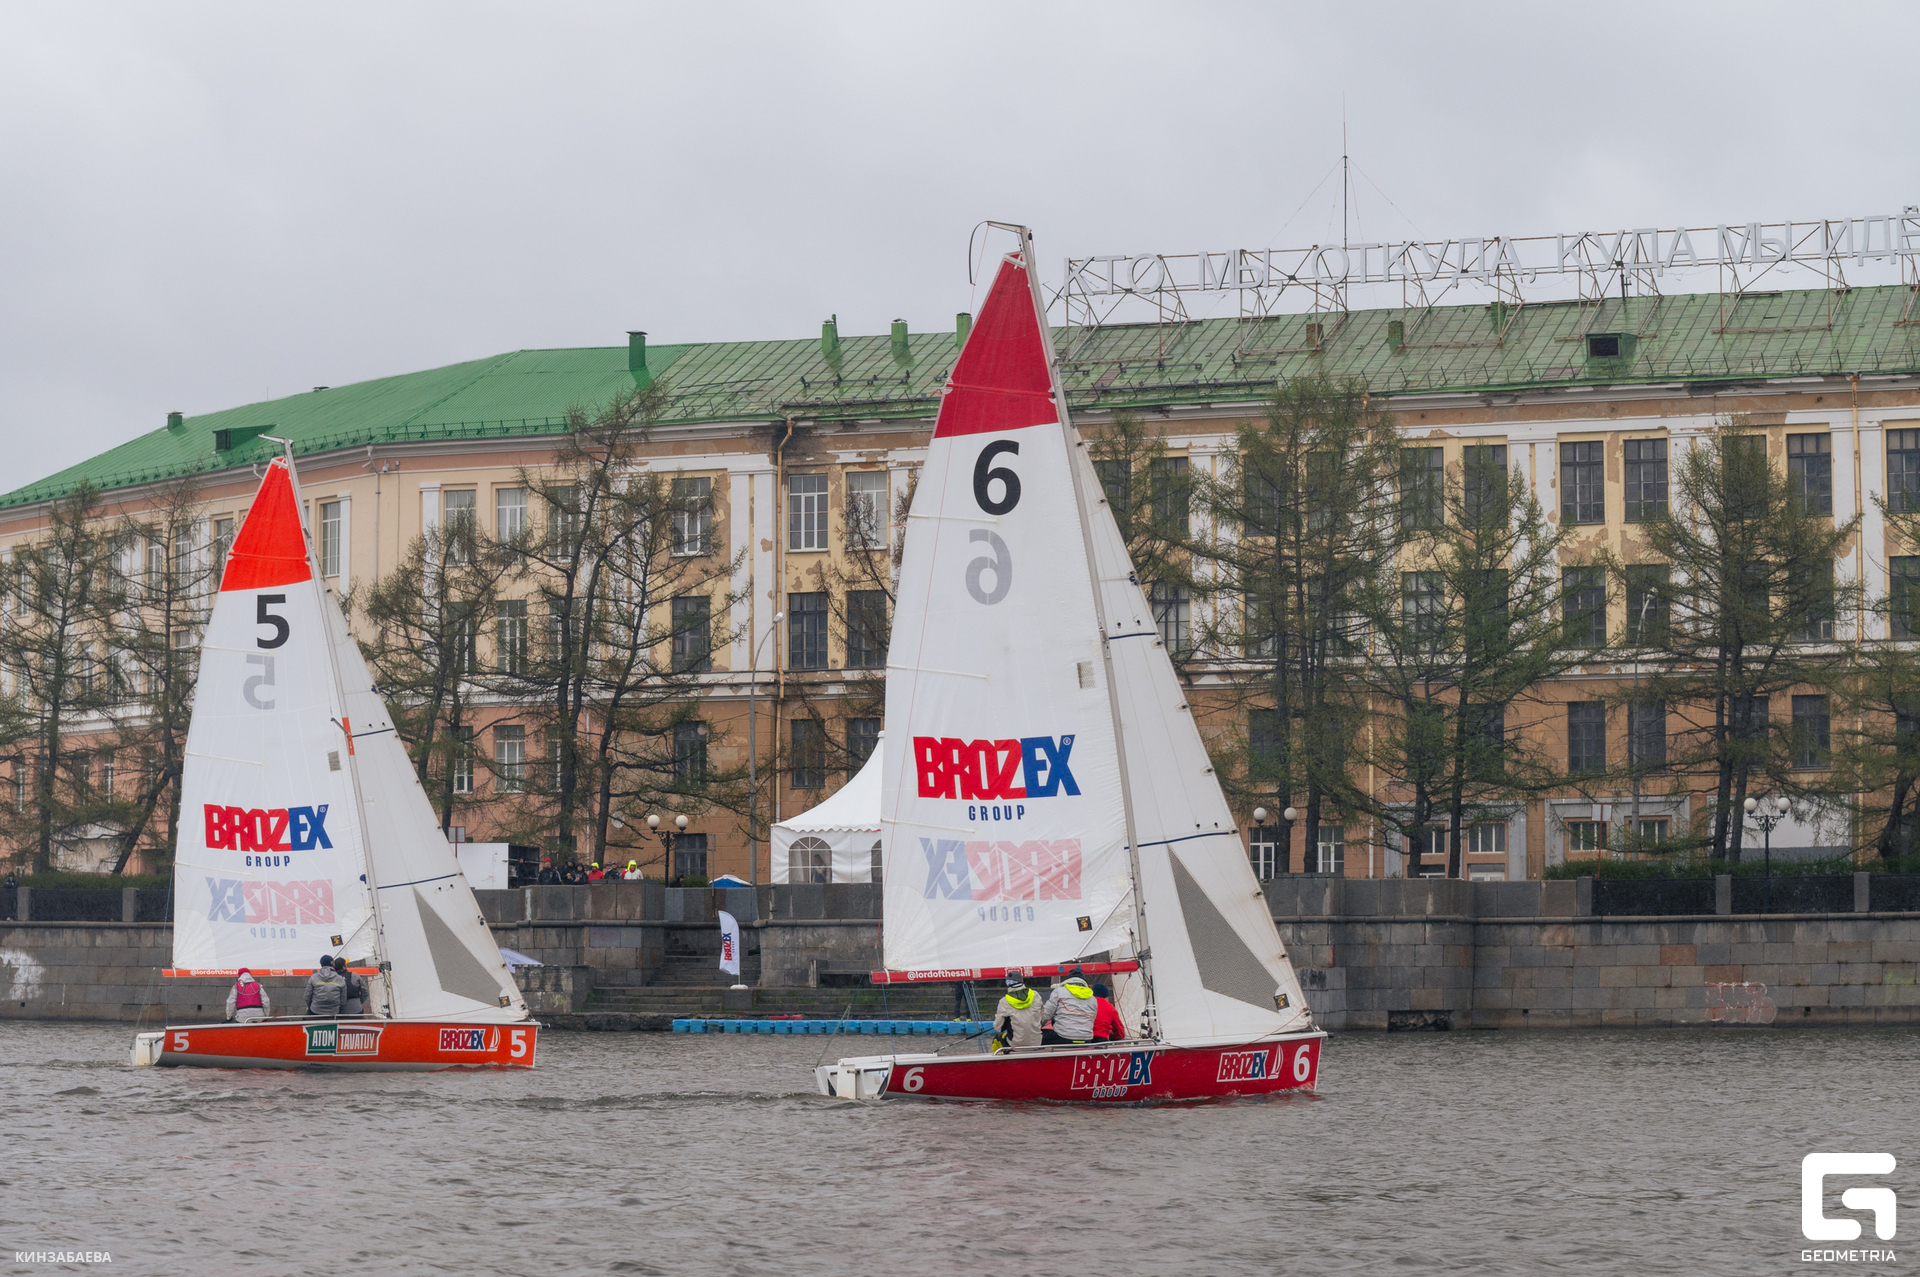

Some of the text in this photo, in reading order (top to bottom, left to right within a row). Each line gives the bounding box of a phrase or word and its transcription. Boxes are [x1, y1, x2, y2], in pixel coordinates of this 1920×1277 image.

[1063, 252, 1165, 297] КТО
[1311, 235, 1537, 288] ОТКУДА,
[1557, 226, 1699, 278] КУДА
[1717, 220, 1792, 265] МЫ
[973, 439, 1021, 516] 6
[257, 594, 290, 649] 5
[968, 805, 1025, 821] GROUP
[246, 855, 291, 867] GROUP
[907, 969, 971, 981] @lordofthesail
[173, 1032, 190, 1052] 5
[312, 1030, 375, 1050] ATOM TAVATUY
[511, 1030, 527, 1058] 5
[1293, 1044, 1310, 1082] 6
[902, 1066, 925, 1092] 6
[1092, 1086, 1128, 1099] GROUP
